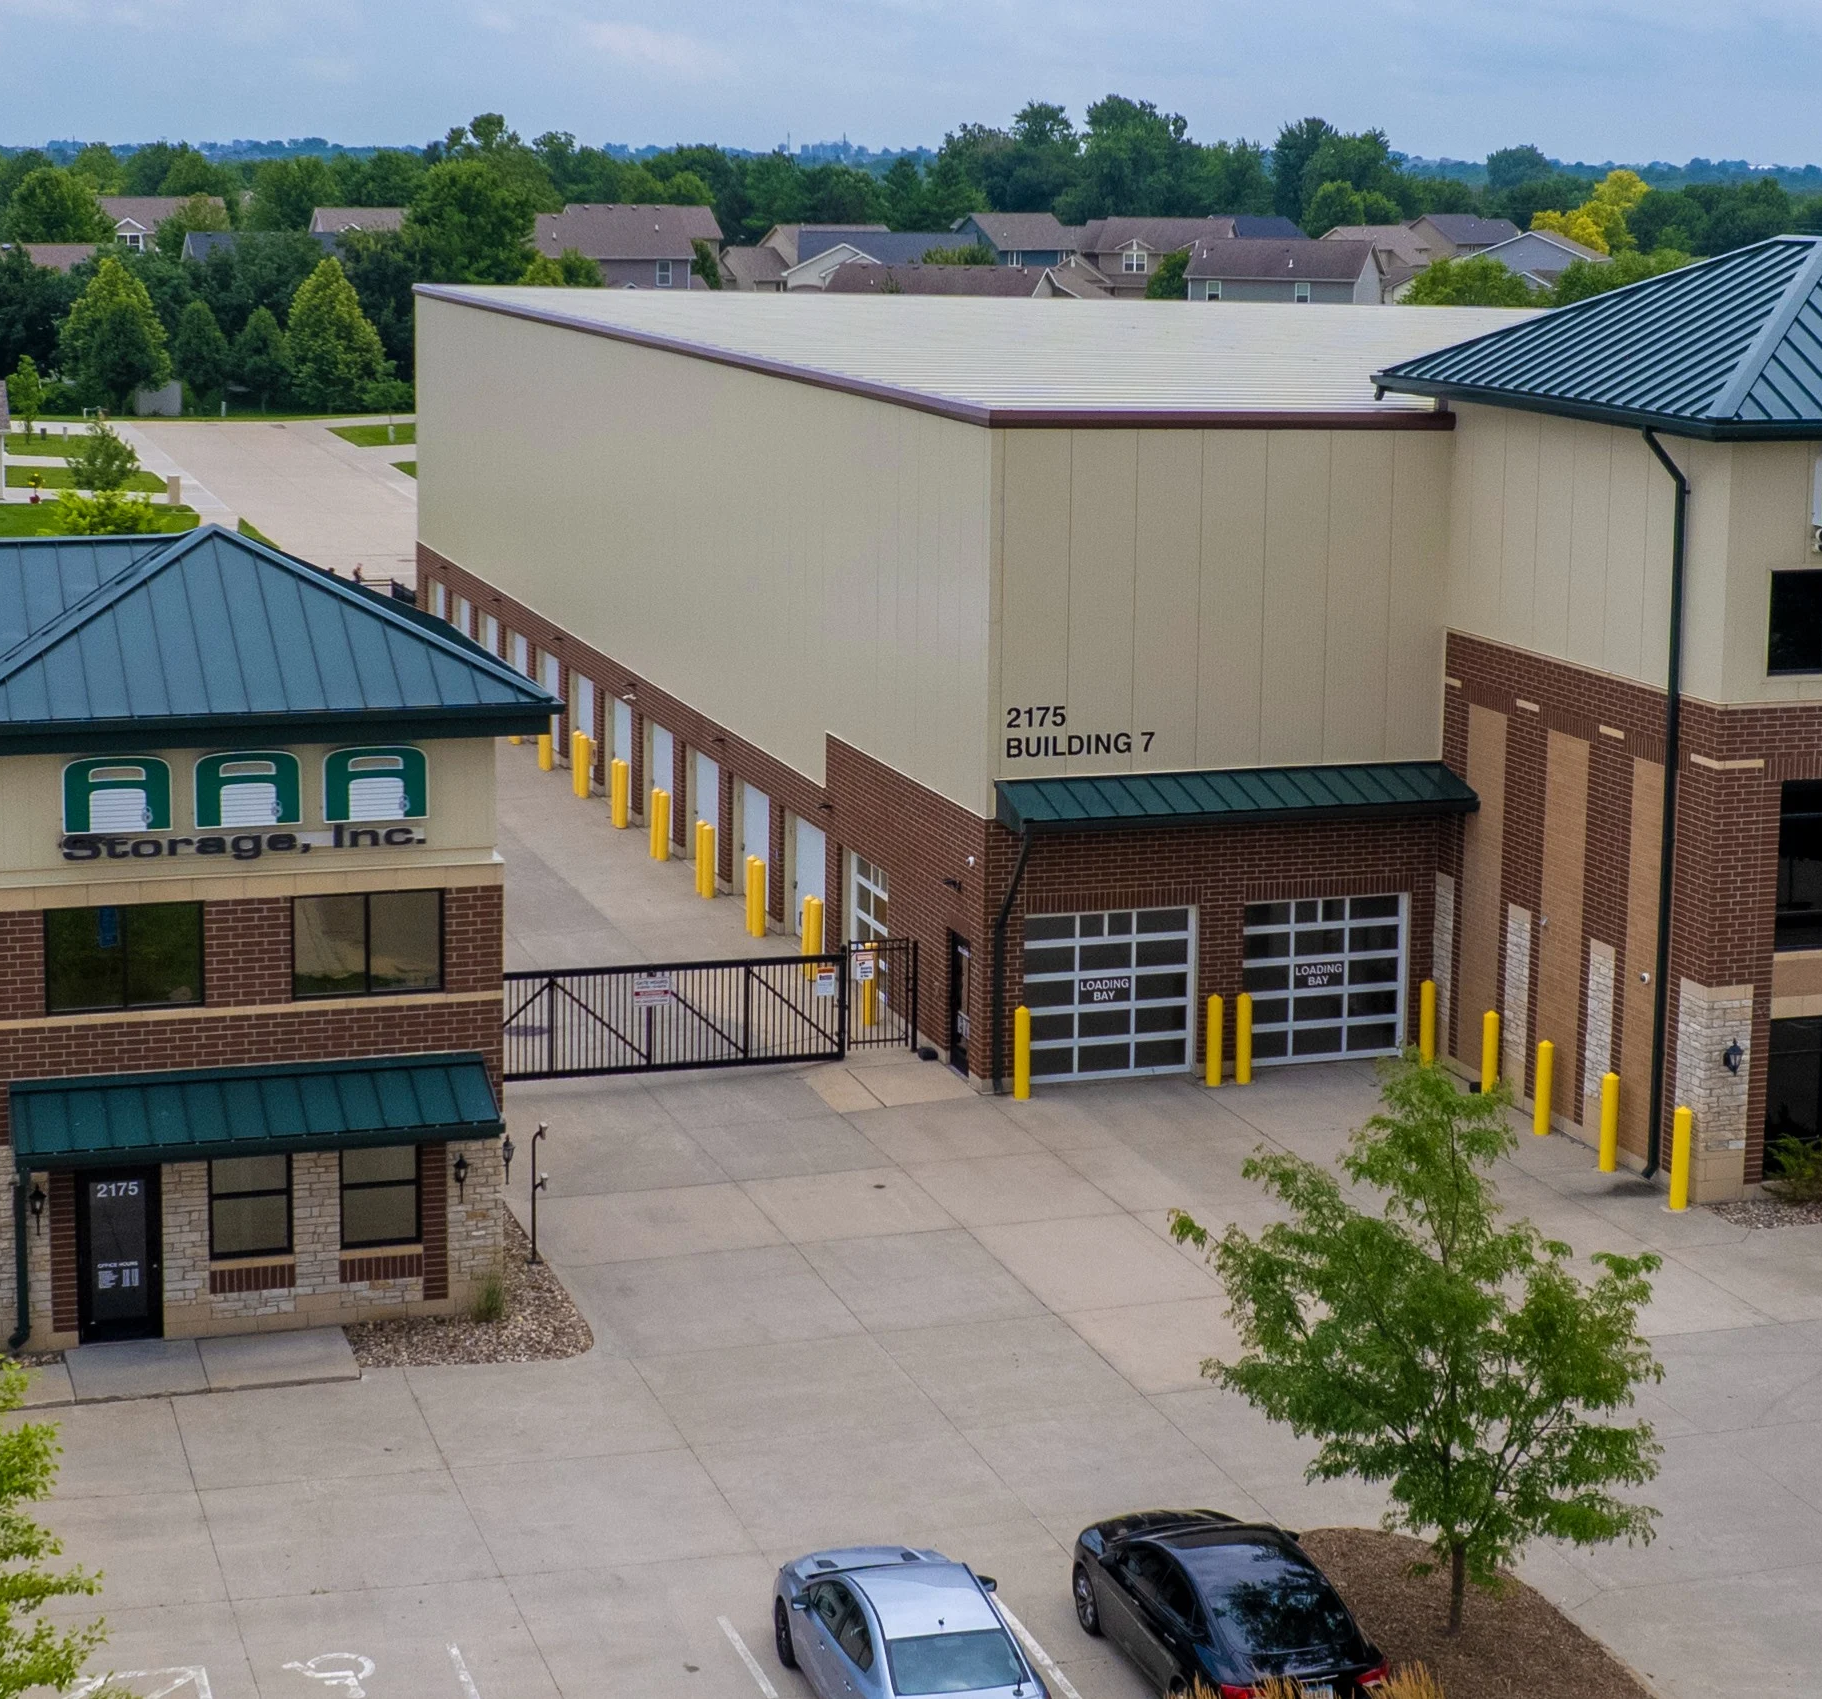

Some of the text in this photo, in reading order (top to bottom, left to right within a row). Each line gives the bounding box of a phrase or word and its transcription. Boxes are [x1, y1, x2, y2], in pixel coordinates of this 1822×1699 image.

[1006, 705, 1067, 729] 2175
[1006, 731, 1156, 759] BUILDING 7
[61, 824, 428, 861] Storage, Inc.
[1295, 963, 1343, 976] LOADING
[1080, 978, 1130, 991] LOADING
[1307, 975, 1330, 986] BAY
[1093, 990, 1116, 1001] BAY
[97, 1181, 139, 1198] 2175
